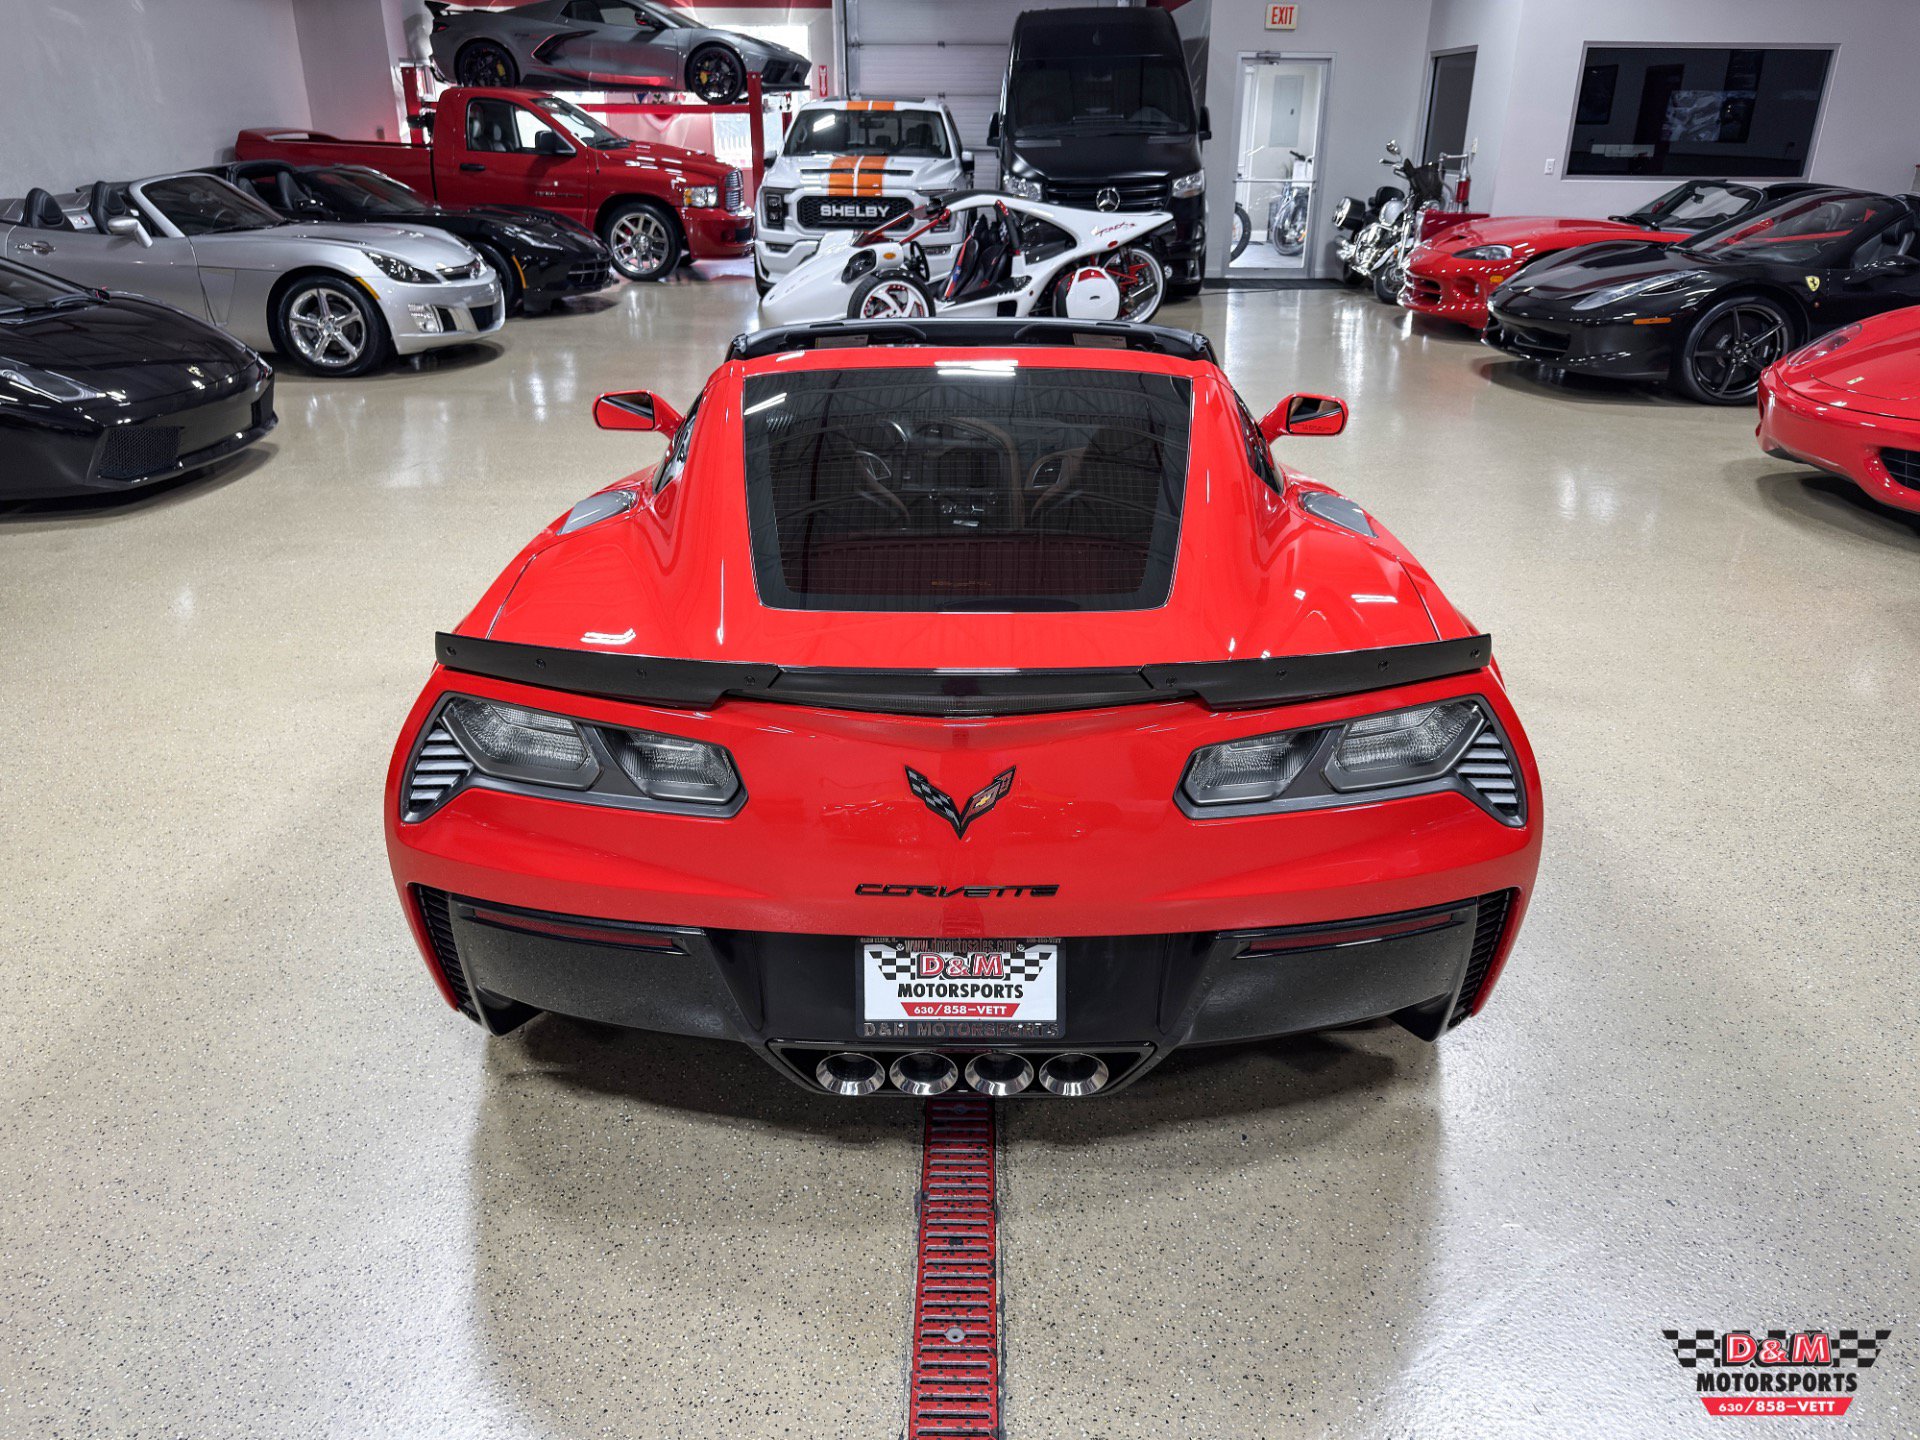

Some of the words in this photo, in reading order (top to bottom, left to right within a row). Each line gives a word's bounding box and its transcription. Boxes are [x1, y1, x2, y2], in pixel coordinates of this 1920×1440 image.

[1271, 6, 1295, 25] EXIT
[820, 204, 890, 218] SHELBY
[854, 883, 1060, 898] CORVETTE
[904, 938, 1017, 953] www.dmautosales.com
[917, 952, 1006, 979] D&M
[897, 983, 1024, 999] MOTORSPORTS
[913, 1003, 1007, 1016] 630/858-VETT
[864, 1022, 910, 1037] D&M
[916, 1022, 1059, 1038] MOTORSPORTS
